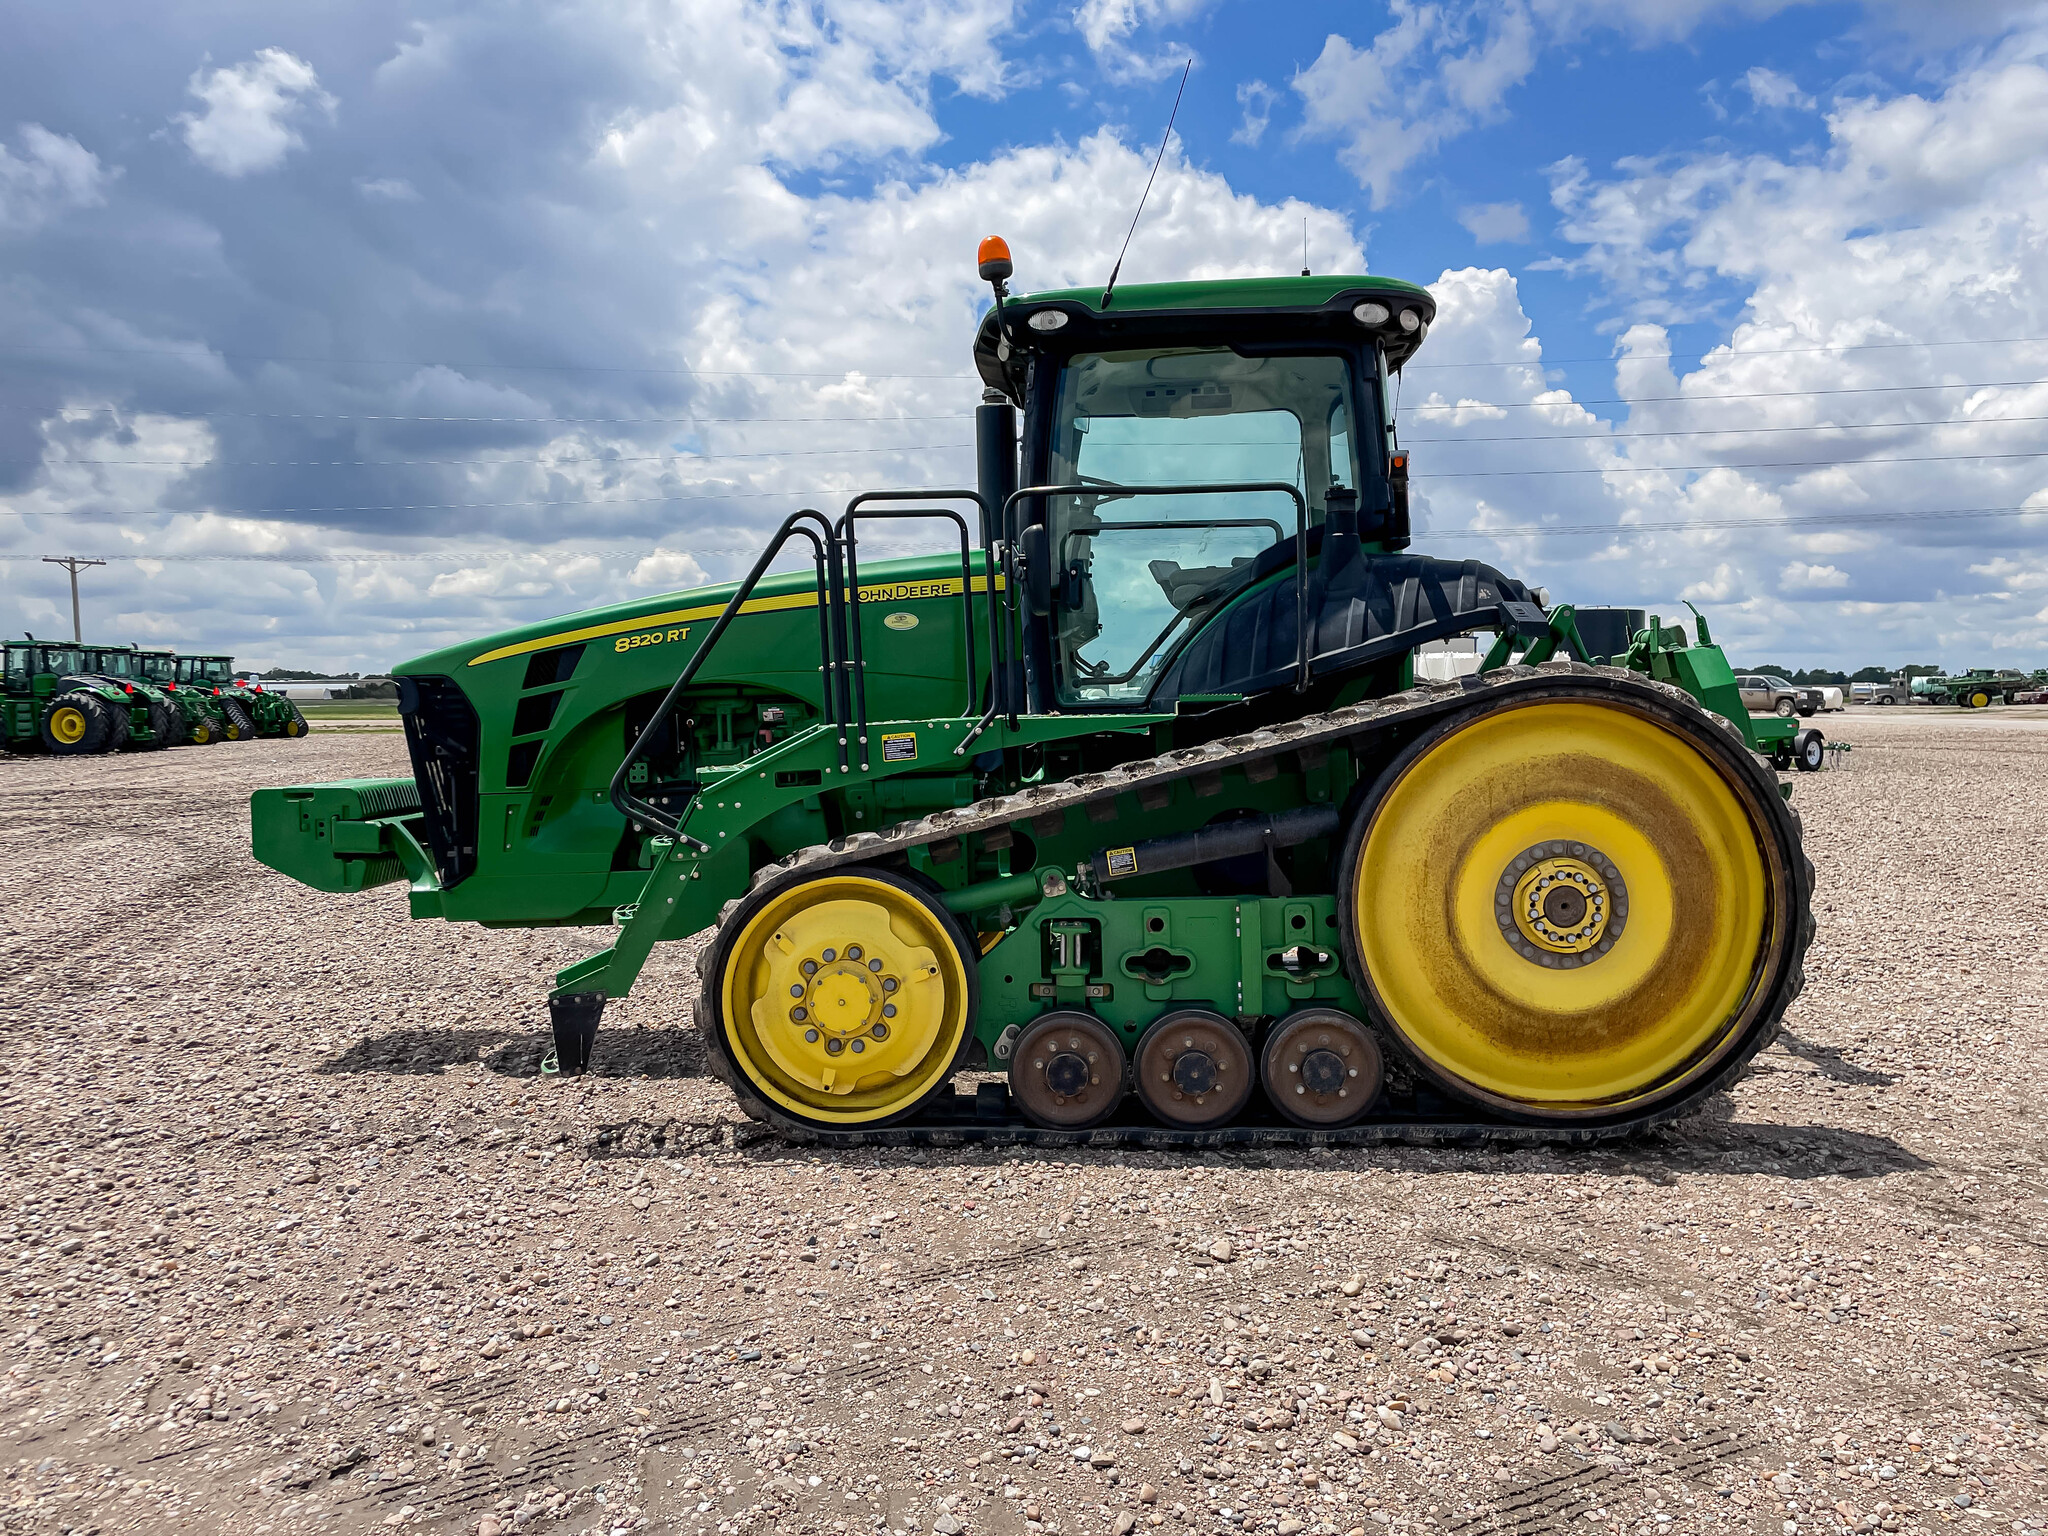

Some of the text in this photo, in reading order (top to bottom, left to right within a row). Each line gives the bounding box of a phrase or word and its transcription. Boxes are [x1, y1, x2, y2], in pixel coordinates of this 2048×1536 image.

[853, 583, 952, 602] OHN DEERE
[614, 627, 691, 653] 8320 RT
